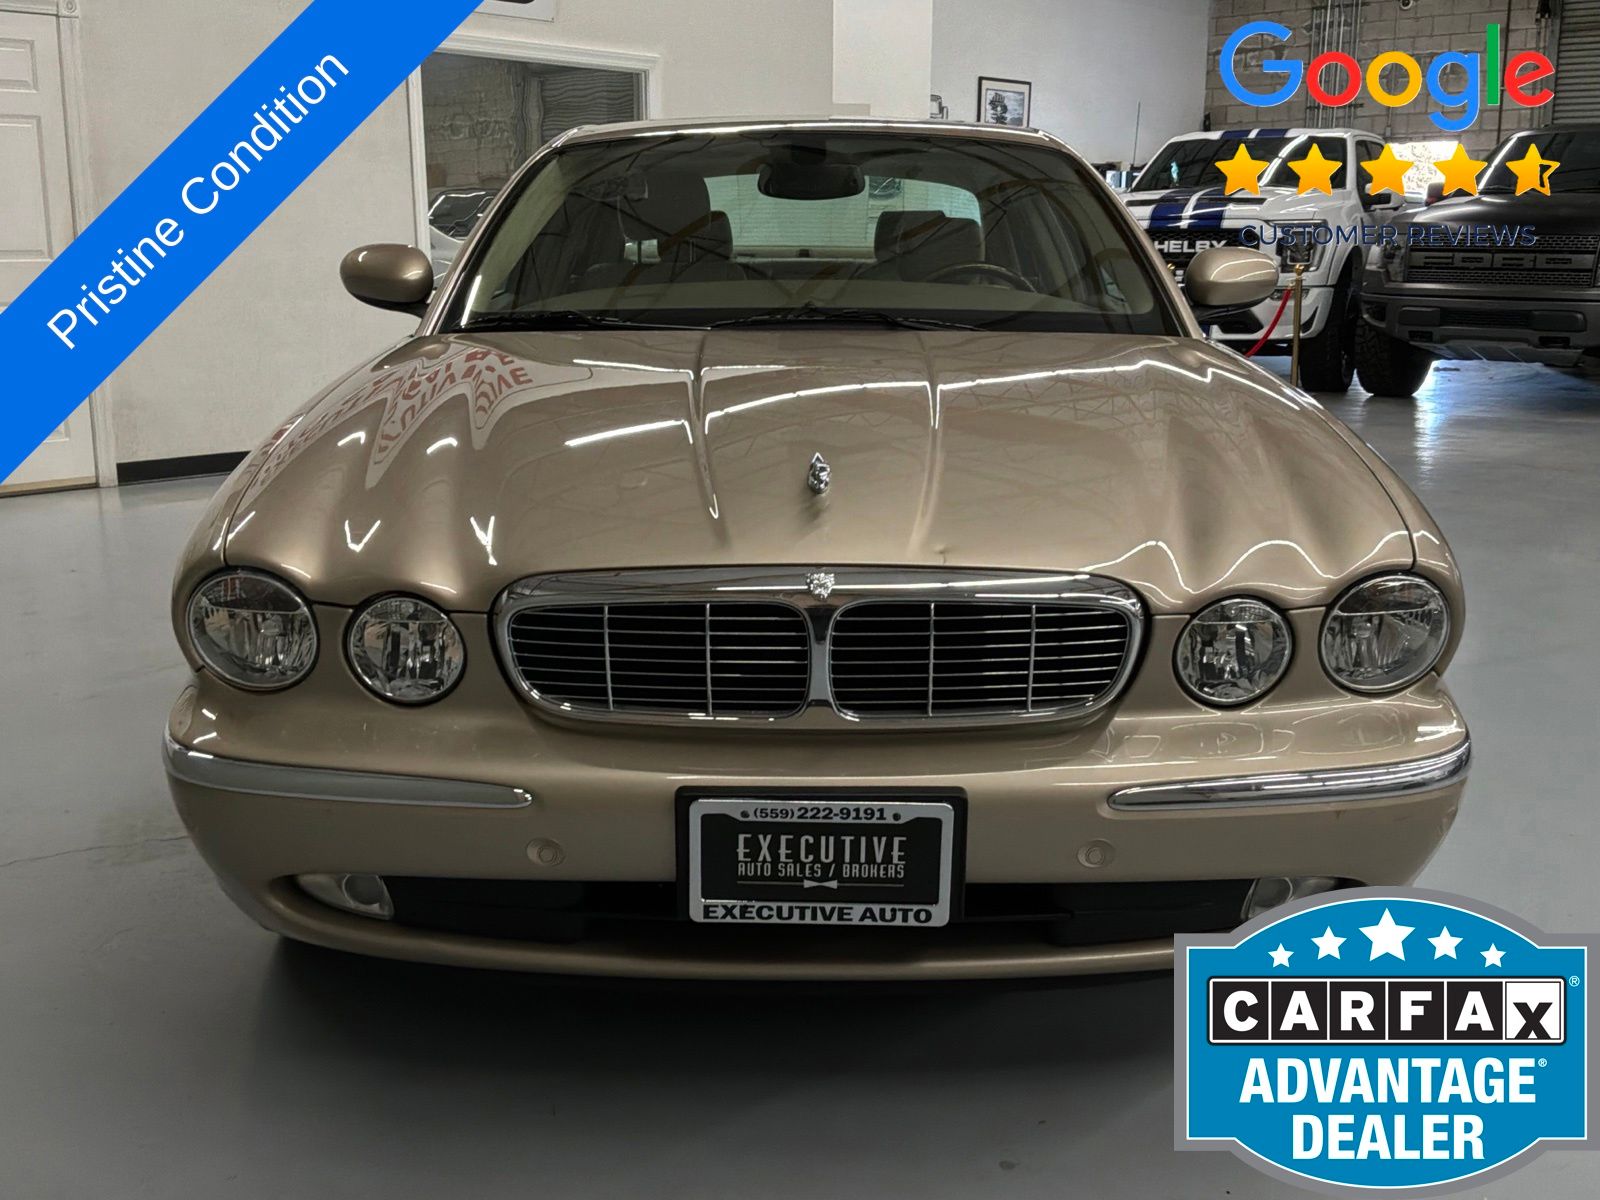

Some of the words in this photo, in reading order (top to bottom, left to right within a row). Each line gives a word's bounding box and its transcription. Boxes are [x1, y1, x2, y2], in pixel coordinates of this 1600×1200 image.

[1153, 240, 1228, 253] HELBY
[753, 807, 795, 820] (559)
[796, 807, 887, 821] 222-9191
[736, 833, 908, 864] EXECUTIVE
[738, 862, 772, 877] AUTO
[778, 862, 822, 878] SALES
[842, 863, 905, 878] BROKERS
[702, 904, 853, 922] EXECUTIVE
[858, 907, 933, 923] AUTO
